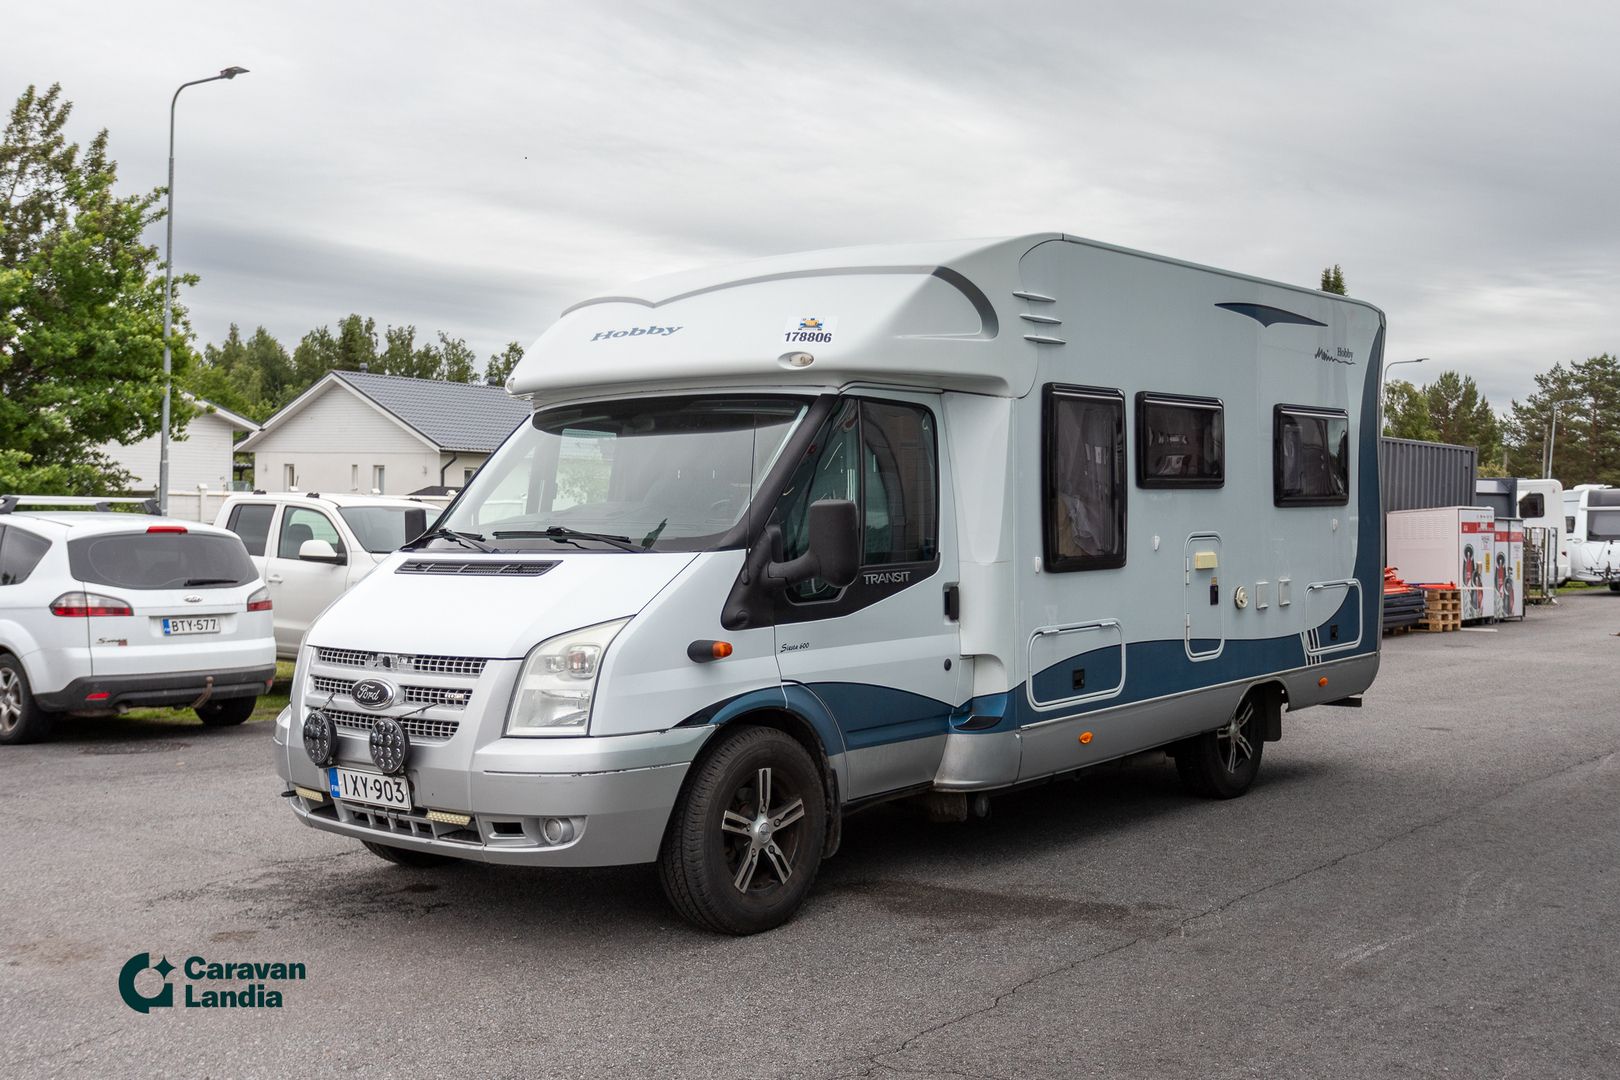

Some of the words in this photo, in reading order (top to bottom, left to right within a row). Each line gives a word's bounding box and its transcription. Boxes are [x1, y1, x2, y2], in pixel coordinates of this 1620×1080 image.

[590, 326, 683, 342] Hobby
[785, 331, 832, 343] 178806
[863, 571, 911, 585] TRANSIT
[171, 619, 217, 632] BTY-577
[799, 642, 810, 650] 600
[356, 684, 380, 701] Ford
[342, 773, 405, 804] IXY-903
